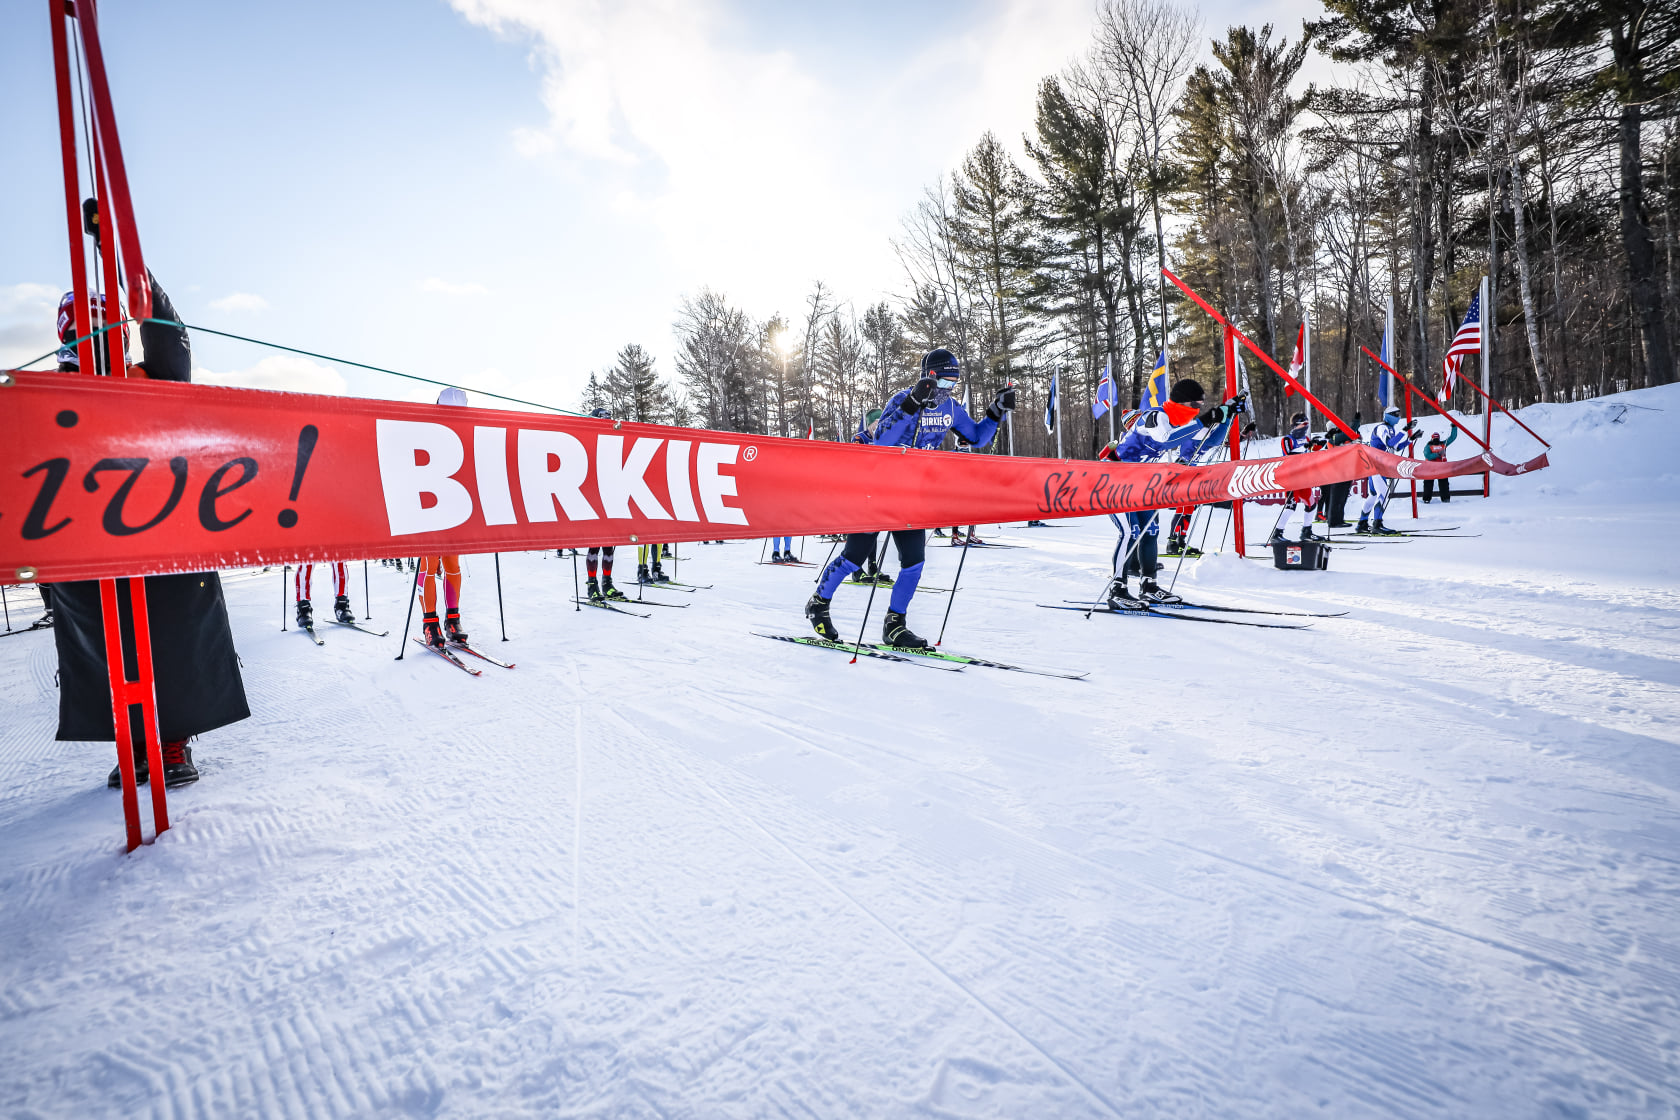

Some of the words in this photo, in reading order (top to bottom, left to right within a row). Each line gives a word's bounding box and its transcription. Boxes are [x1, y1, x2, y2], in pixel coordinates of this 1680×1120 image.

[921, 416, 943, 426] BIRKIE
[0, 409, 319, 541] ive!
[1037, 470, 1085, 514] Ski.
[1089, 473, 1138, 511] Run.
[1227, 460, 1286, 499] BIRKIE
[891, 646, 910, 654] ONE
[911, 648, 930, 656] WAY
